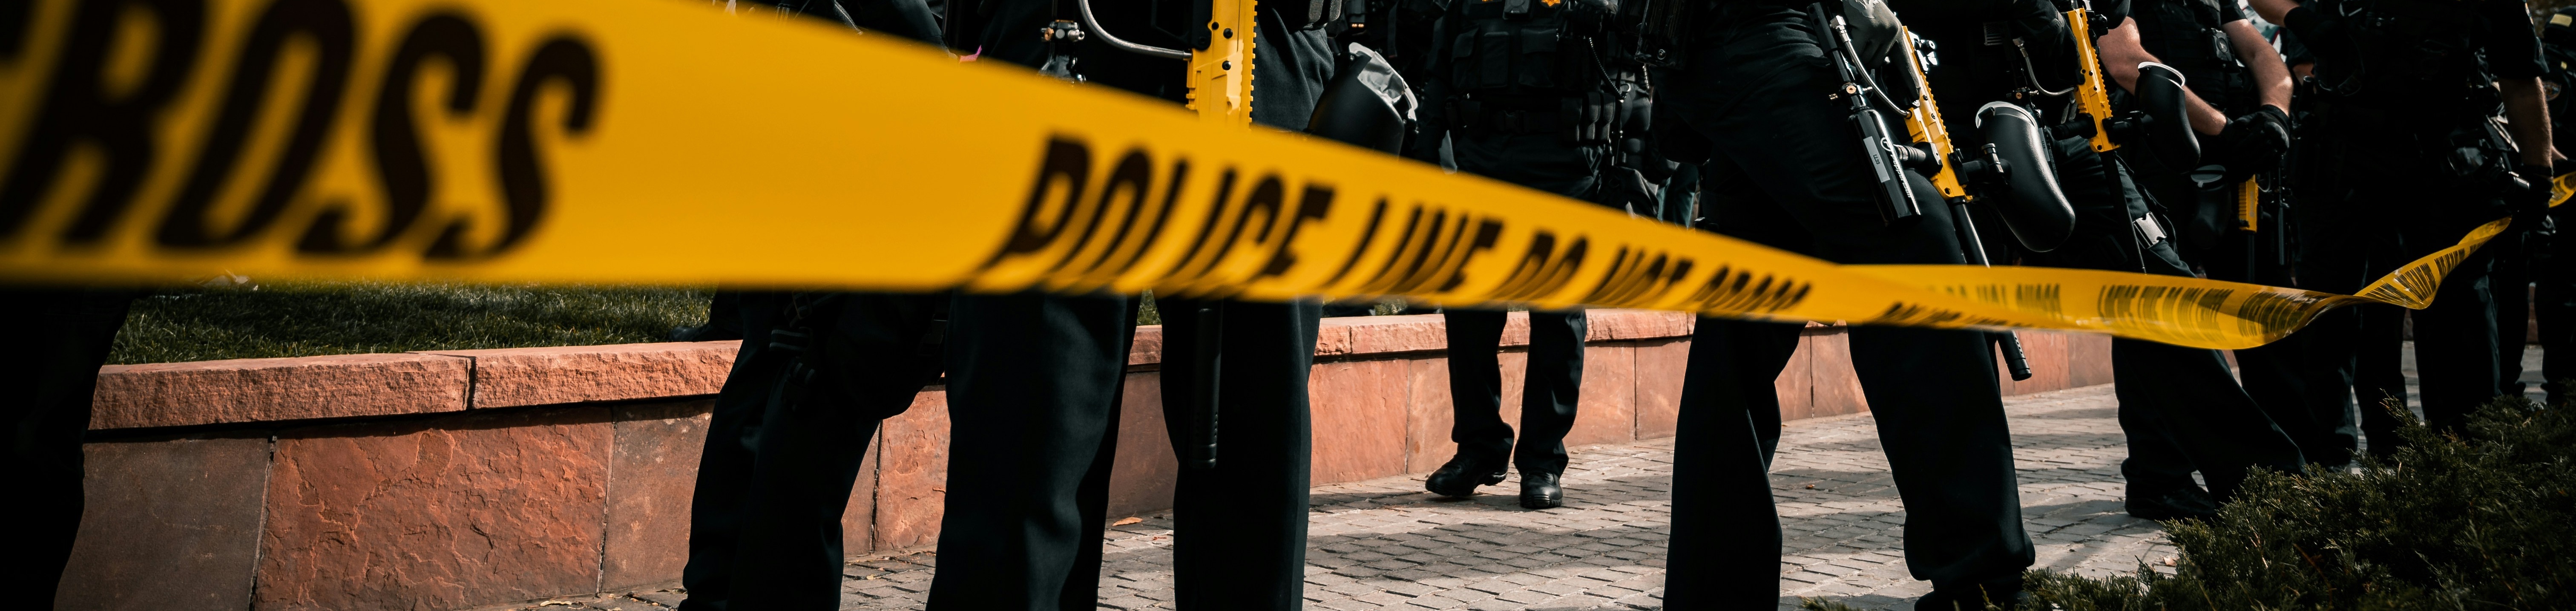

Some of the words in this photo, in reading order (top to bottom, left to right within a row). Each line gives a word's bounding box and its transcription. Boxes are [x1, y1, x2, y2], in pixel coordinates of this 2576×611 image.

[0, 0, 608, 263] ROSS
[979, 132, 1337, 281] POLICE
[1322, 196, 1504, 294] LINE
